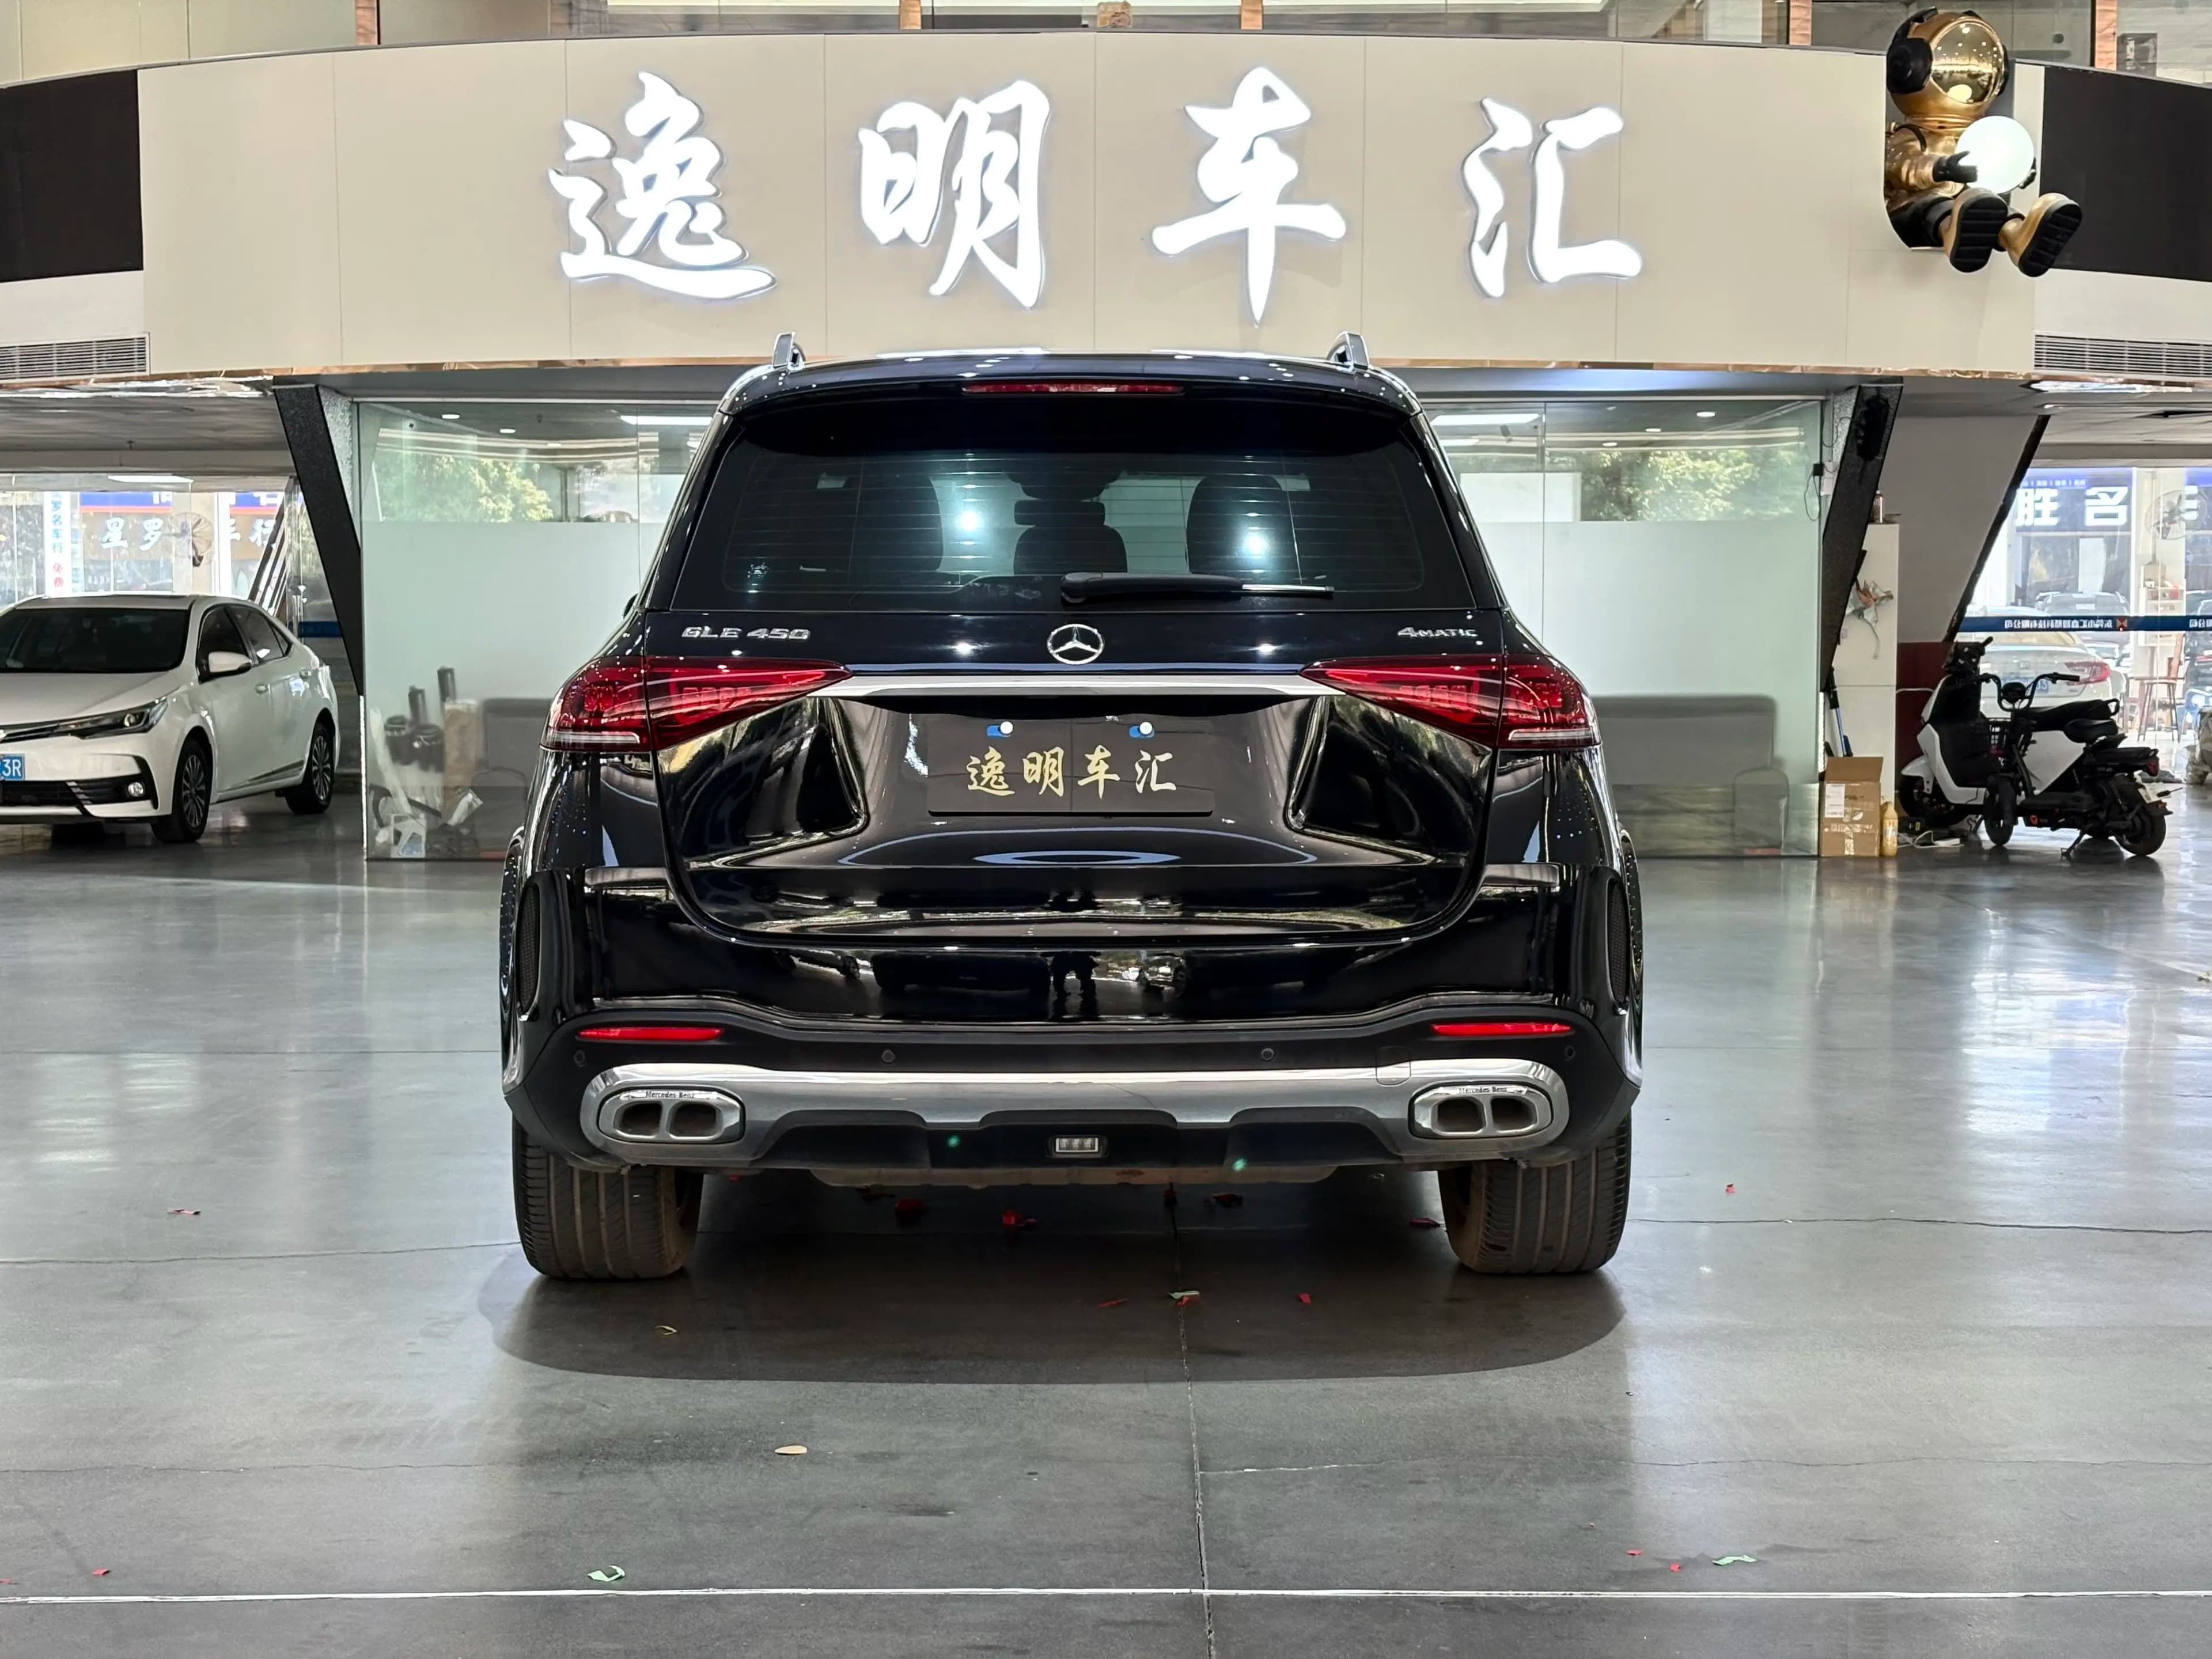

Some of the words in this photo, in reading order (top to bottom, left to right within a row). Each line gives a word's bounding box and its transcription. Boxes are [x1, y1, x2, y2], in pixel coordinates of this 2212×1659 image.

[548, 67, 1642, 324] 逸明车汇
[51, 492, 63, 554] 罗名车行
[681, 626, 742, 638] GLE
[747, 628, 811, 640] 450
[1397, 627, 1478, 638] 4MATIC
[0, 759, 21, 777] 3R
[966, 744, 1176, 799] 逸明车汇
